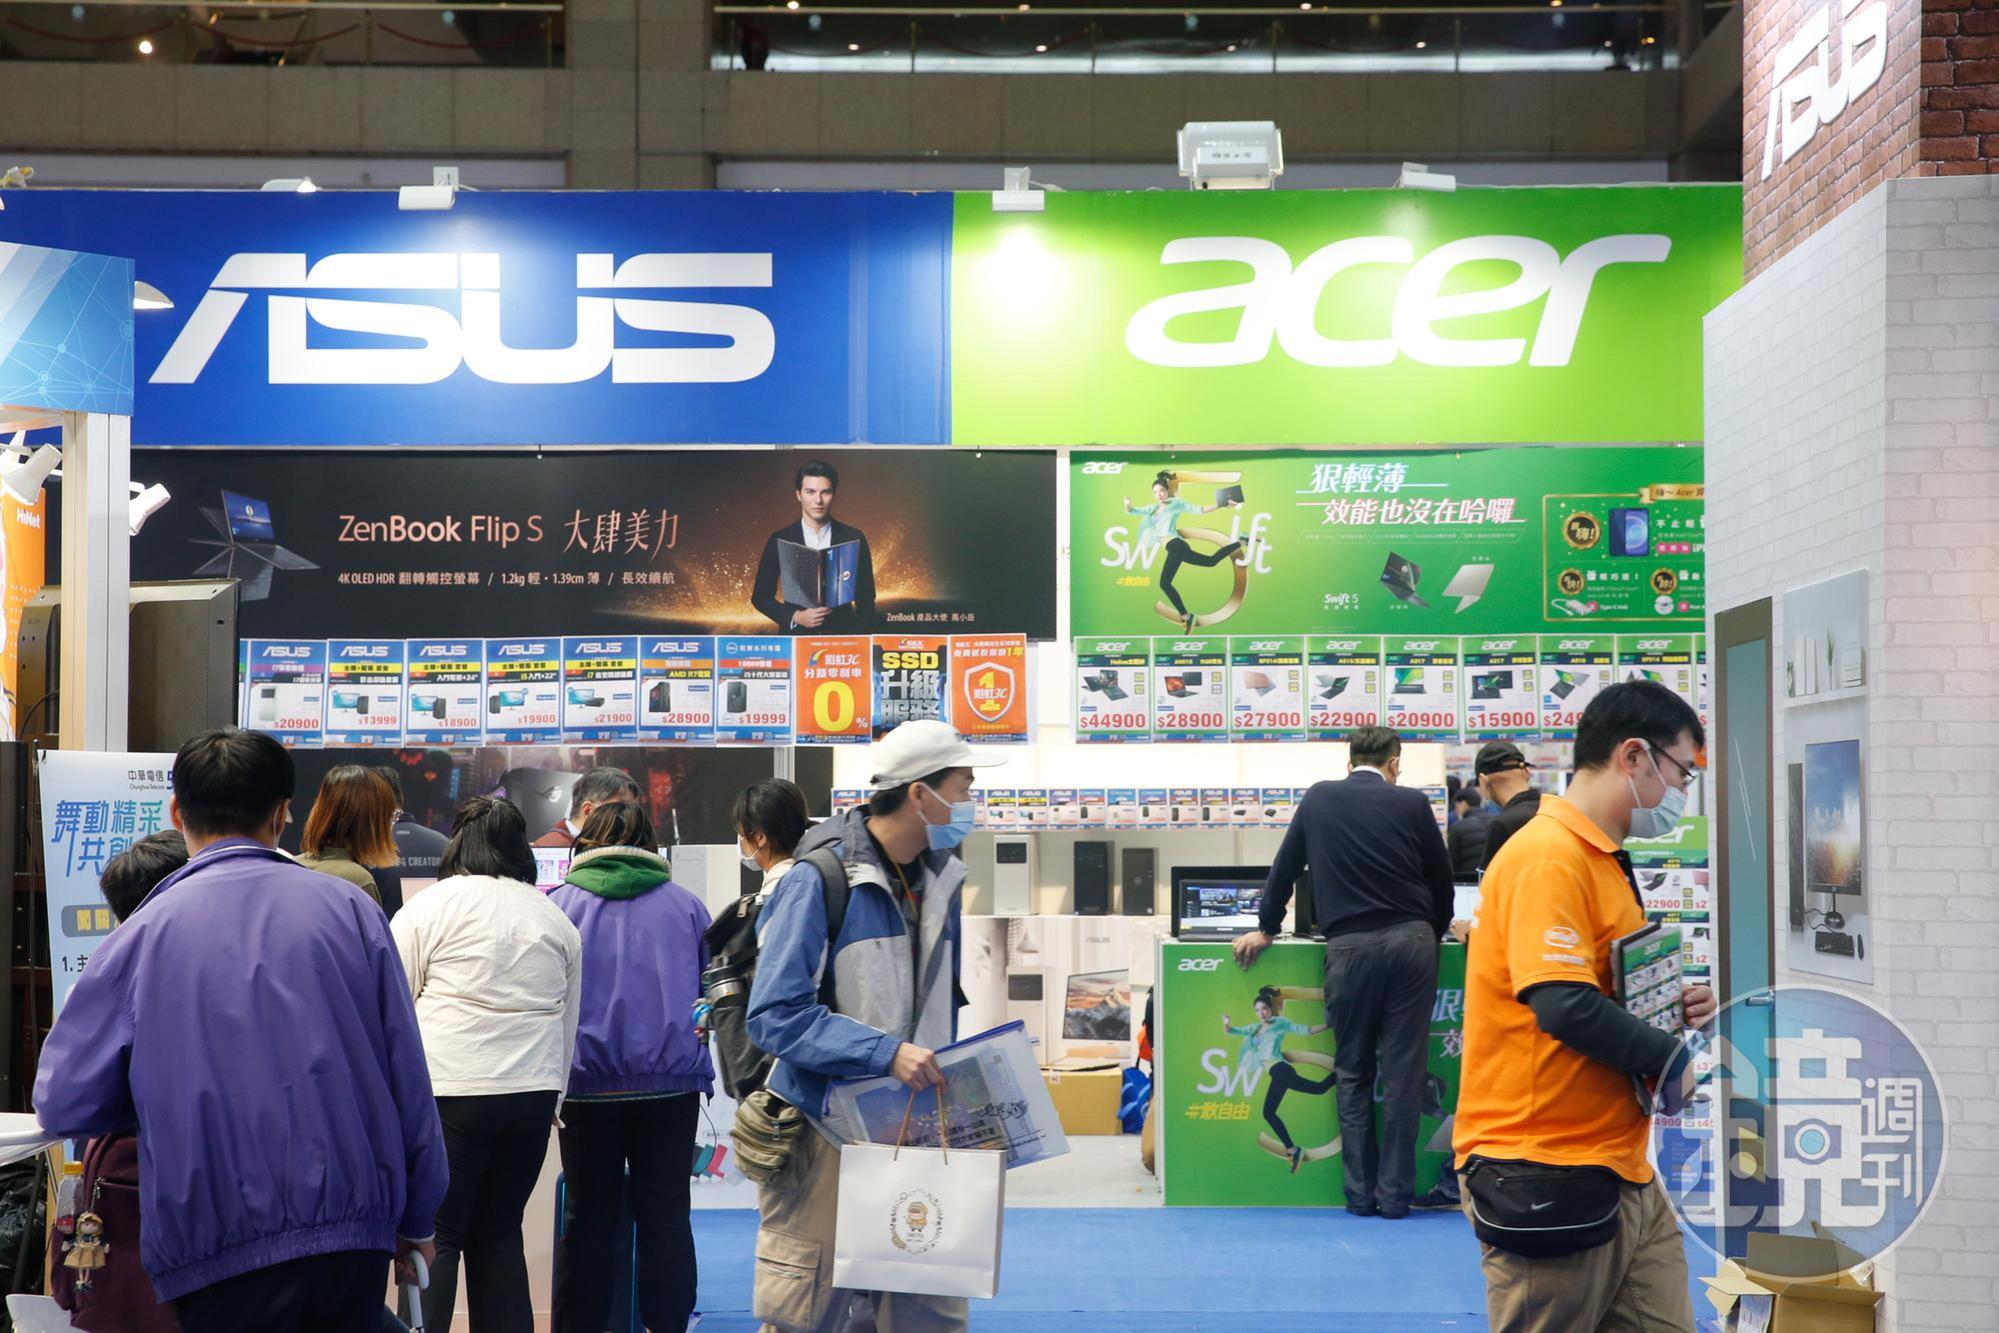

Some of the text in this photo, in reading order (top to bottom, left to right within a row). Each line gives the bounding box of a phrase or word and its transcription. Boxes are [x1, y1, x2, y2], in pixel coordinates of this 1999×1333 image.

[1125, 234, 1672, 369] acer
[149, 252, 775, 385] ASUS
[1082, 462, 1128, 474] acer
[17, 508, 40, 528] HiNet
[338, 514, 543, 548] ZenBook Flip S
[563, 509, 679, 560] 大肆美力
[338, 573, 350, 585] 4K
[352, 573, 373, 585] OLED
[375, 573, 395, 585] HDR
[398, 572, 480, 586] 翻轉觸控螢幕
[501, 573, 525, 587] 1.2kg
[527, 572, 541, 585] 輕
[553, 573, 585, 585] 1.39cm
[587, 572, 600, 585] 薄
[622, 572, 675, 585] 長效續航
[1324, 593, 1359, 605] Swift 5
[887, 613, 916, 623] ZenBook
[340, 646, 388, 656] ASUS
[420, 644, 468, 656] ASUS
[498, 644, 545, 656] ASUS
[575, 642, 622, 654] ASUS
[652, 642, 700, 653] ASUS
[1096, 642, 1131, 652] acer
[1172, 642, 1208, 652] acer
[1249, 640, 1285, 651] acer
[1326, 640, 1362, 650] acer
[1404, 640, 1440, 651] acer
[1482, 640, 1518, 650] acer
[1558, 640, 1594, 650] acer
[1636, 640, 1673, 650] acer
[262, 646, 312, 657] ASUS
[882, 652, 939, 670] SSD
[880, 670, 940, 700] 升級
[813, 681, 855, 732] 0
[275, 718, 320, 729] $20900
[358, 716, 397, 725] $13999
[439, 718, 476, 728] $18900
[518, 714, 556, 724] $19900
[595, 713, 632, 723] $21900
[662, 713, 710, 724] $28900
[739, 713, 786, 724] $19999
[856, 716, 868, 729] %
[1080, 713, 1146, 728] $44900
[1158, 713, 1223, 728] $28900
[1234, 712, 1300, 728] $27900
[1310, 712, 1376, 728] $22900
[1388, 712, 1454, 728] $20900
[1468, 712, 1535, 728] $15900
[128, 770, 164, 782] 中華電信
[51, 800, 163, 867] 舞動精采
[62, 955, 74, 972] 1.
[1177, 958, 1224, 971] acer
[1184, 1102, 1251, 1121] #敢自由
